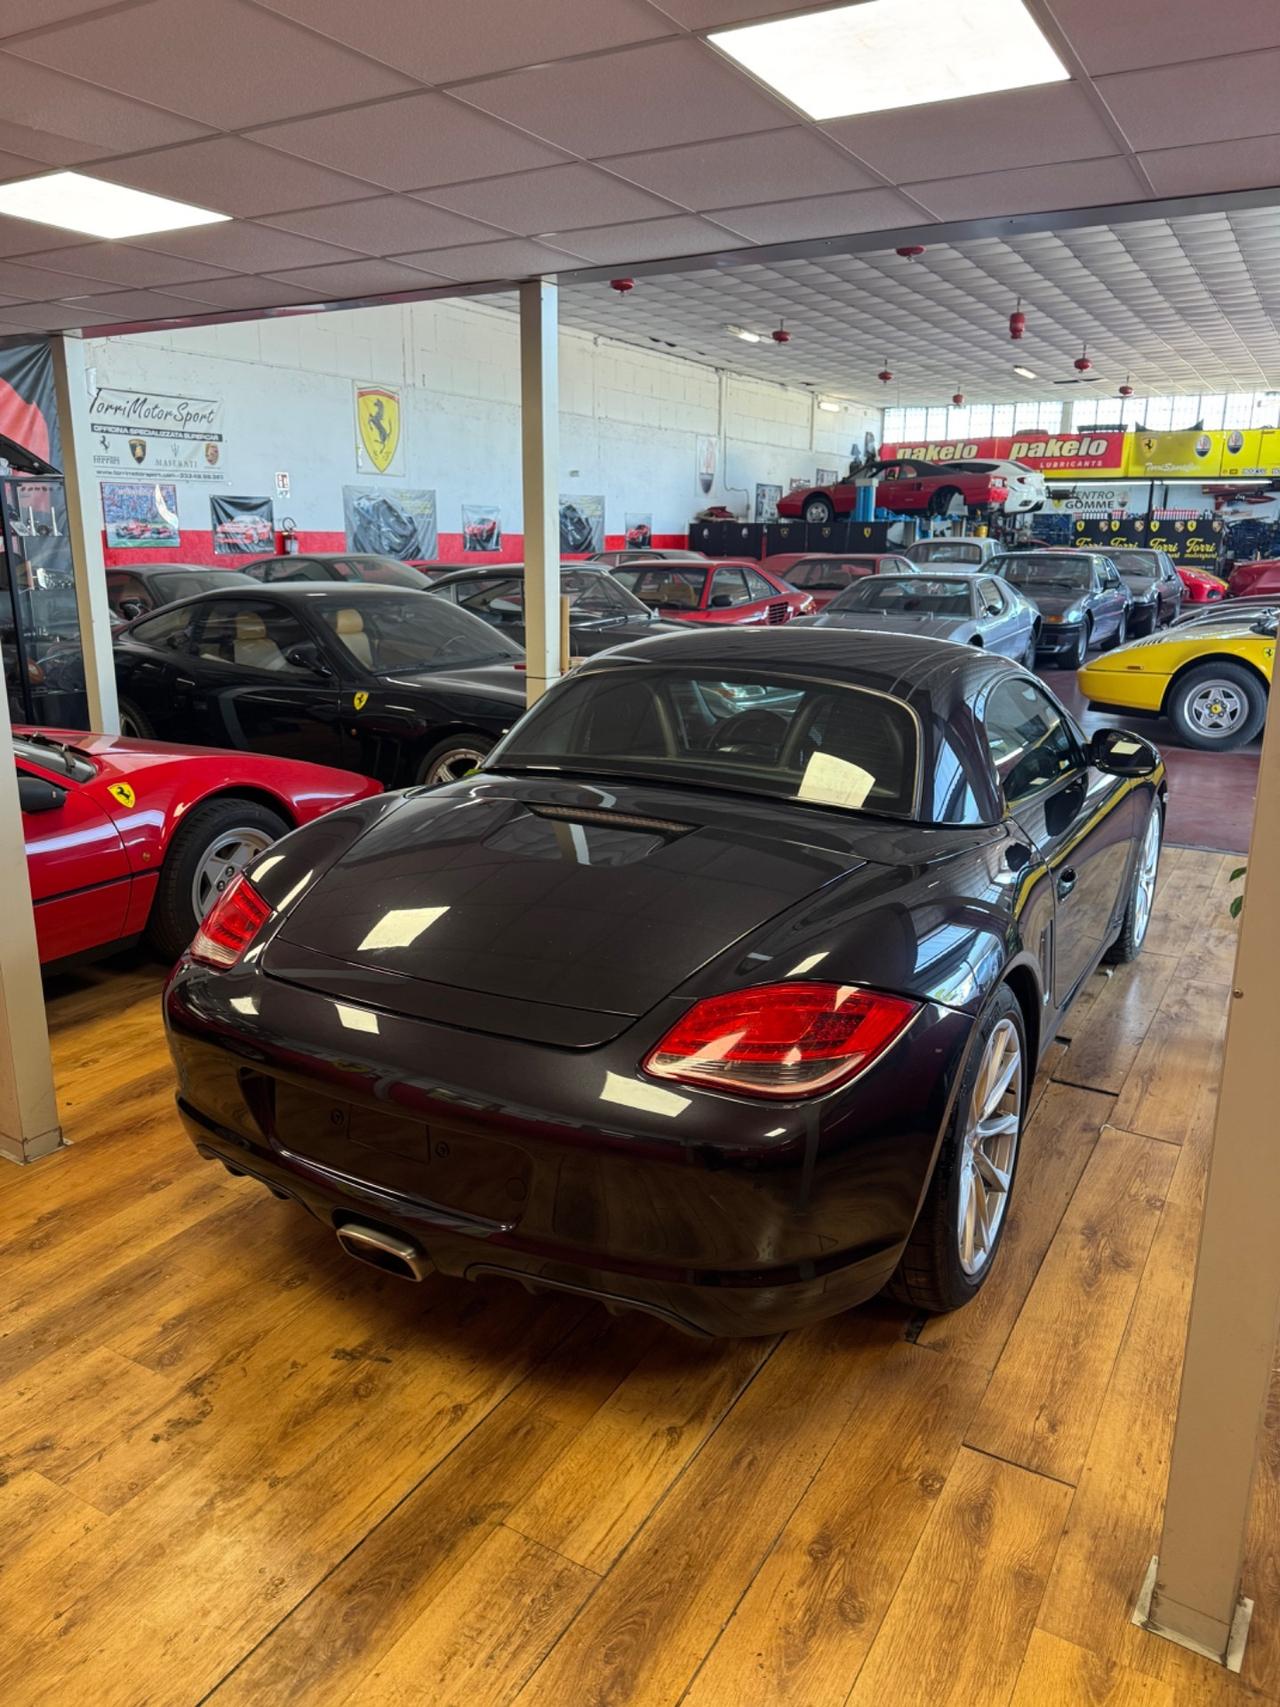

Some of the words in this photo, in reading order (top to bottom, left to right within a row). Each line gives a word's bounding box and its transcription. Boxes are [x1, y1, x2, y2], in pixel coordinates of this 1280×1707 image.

[89, 388, 217, 429] TorriMotorSport
[93, 425, 129, 434] OFFICINA
[1009, 437, 1108, 461] pakelo
[1072, 490, 1115, 500] ENTRO
[1065, 500, 1114, 509] GOMME
[1149, 537, 1179, 552] Torri
[1186, 537, 1217, 553] Torri
